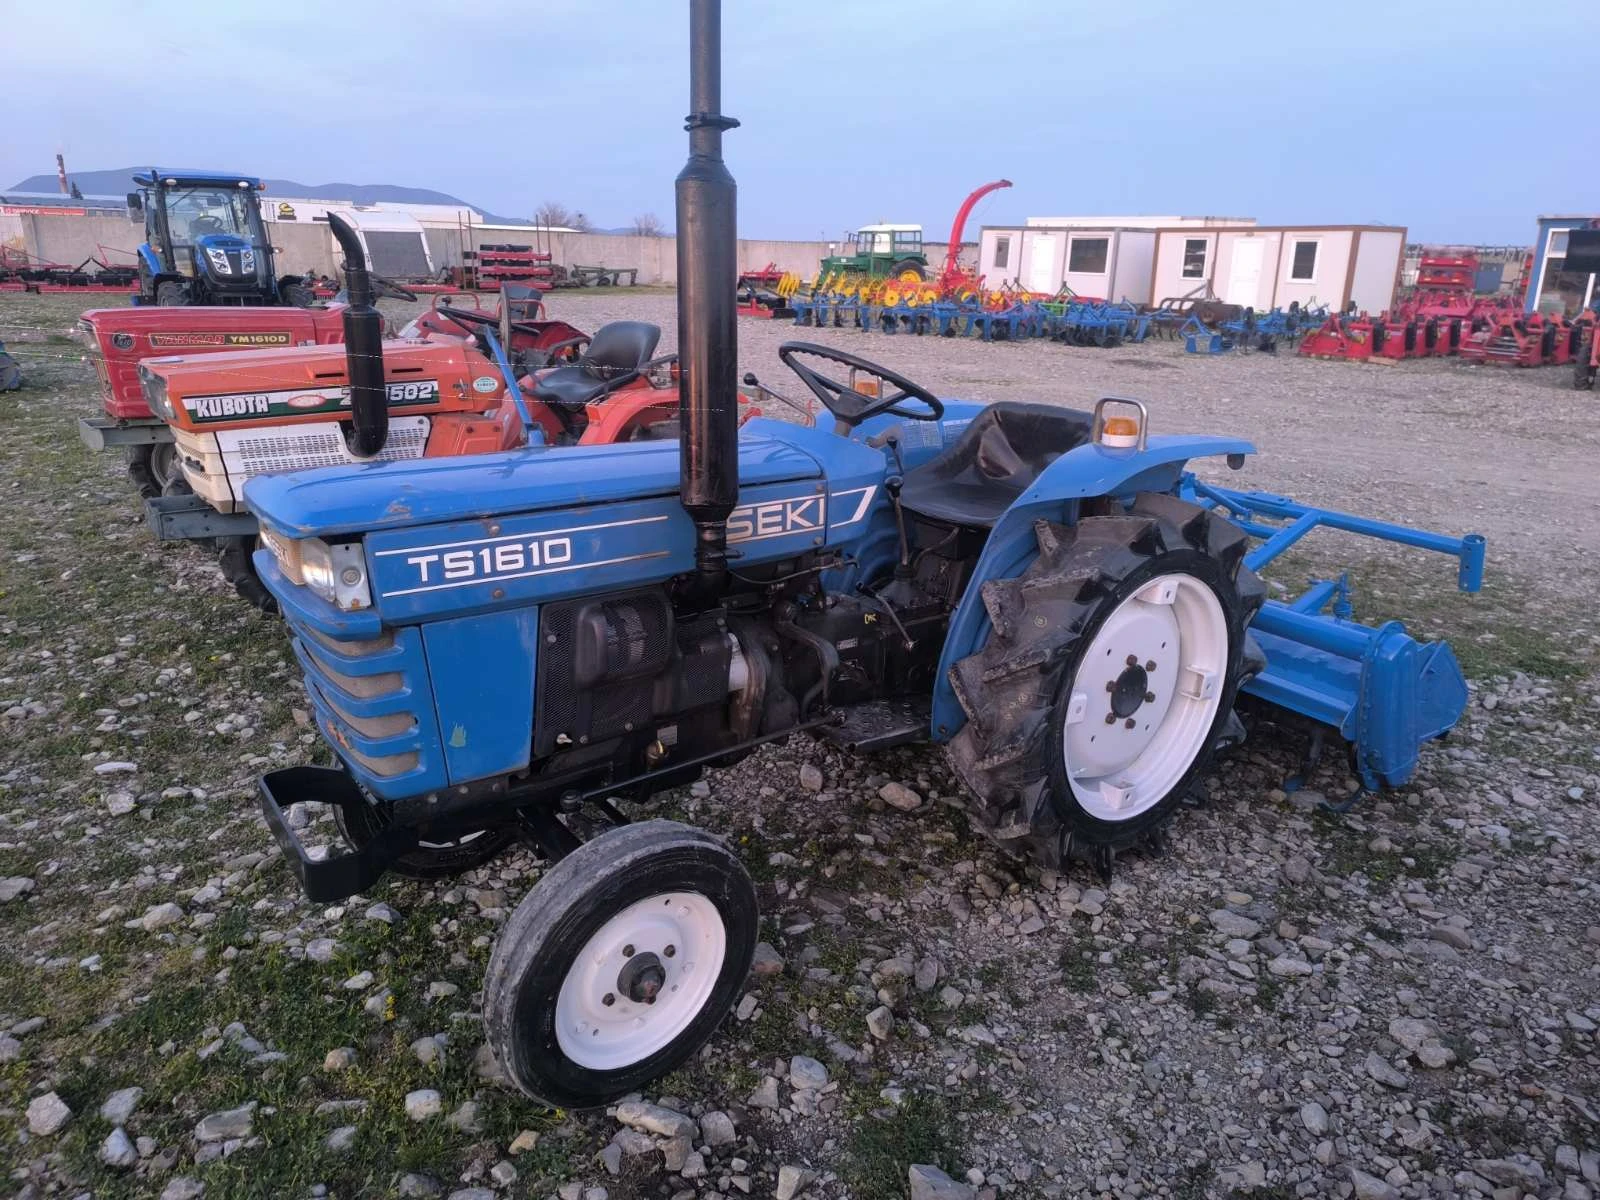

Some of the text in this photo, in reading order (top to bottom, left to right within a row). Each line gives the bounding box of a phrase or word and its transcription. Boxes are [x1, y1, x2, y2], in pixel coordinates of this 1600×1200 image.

[230, 335, 287, 344] YM1610D
[196, 395, 269, 418] KUBOTA
[726, 498, 825, 540] SEKI
[407, 537, 572, 582] TS1610
